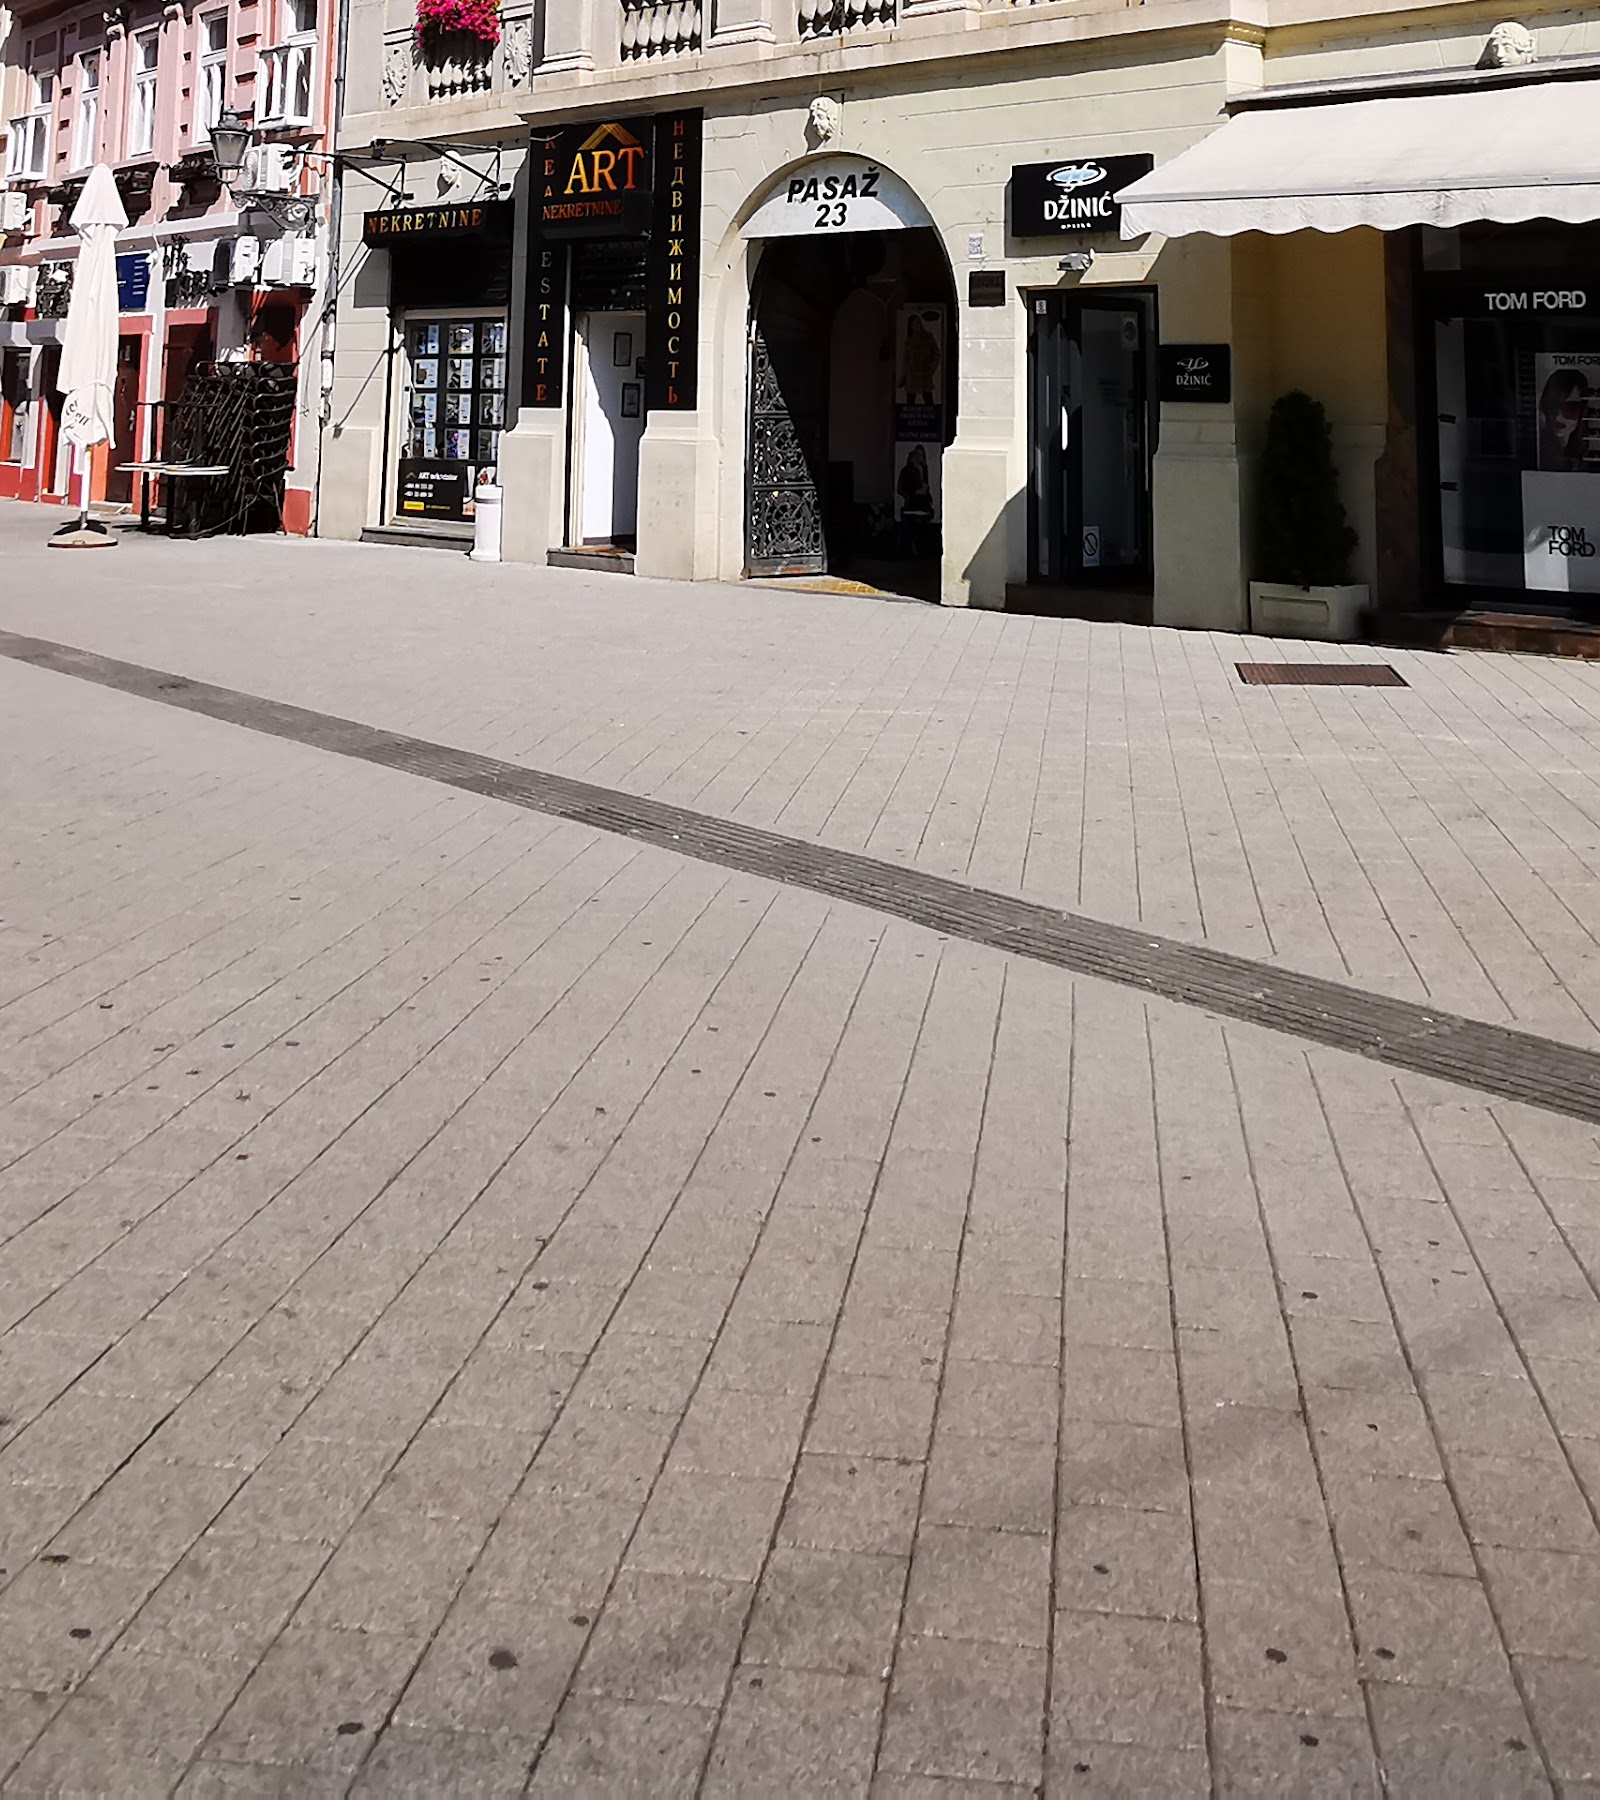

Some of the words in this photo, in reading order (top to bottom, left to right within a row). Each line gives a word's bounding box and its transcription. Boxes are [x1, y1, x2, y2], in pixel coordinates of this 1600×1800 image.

[563, 146, 645, 195] ART
[786, 166, 880, 203] PASAŽ
[542, 200, 622, 220] NEKRETNINE
[814, 202, 848, 228] 23
[1043, 190, 1113, 220] DŽINIĆ
[368, 208, 483, 234] NEKRETNINE
[667, 120, 685, 404] НЕДВИЖИМОСТЬ
[1484, 292, 1527, 310] TOM
[1532, 290, 1587, 309] FORD
[535, 251, 553, 401] ESTATE
[1551, 355, 1577, 366] TOM
[1175, 372, 1212, 387] DŽINIĆ
[1547, 525, 1586, 542] TOM
[1548, 540, 1596, 558] FORD
